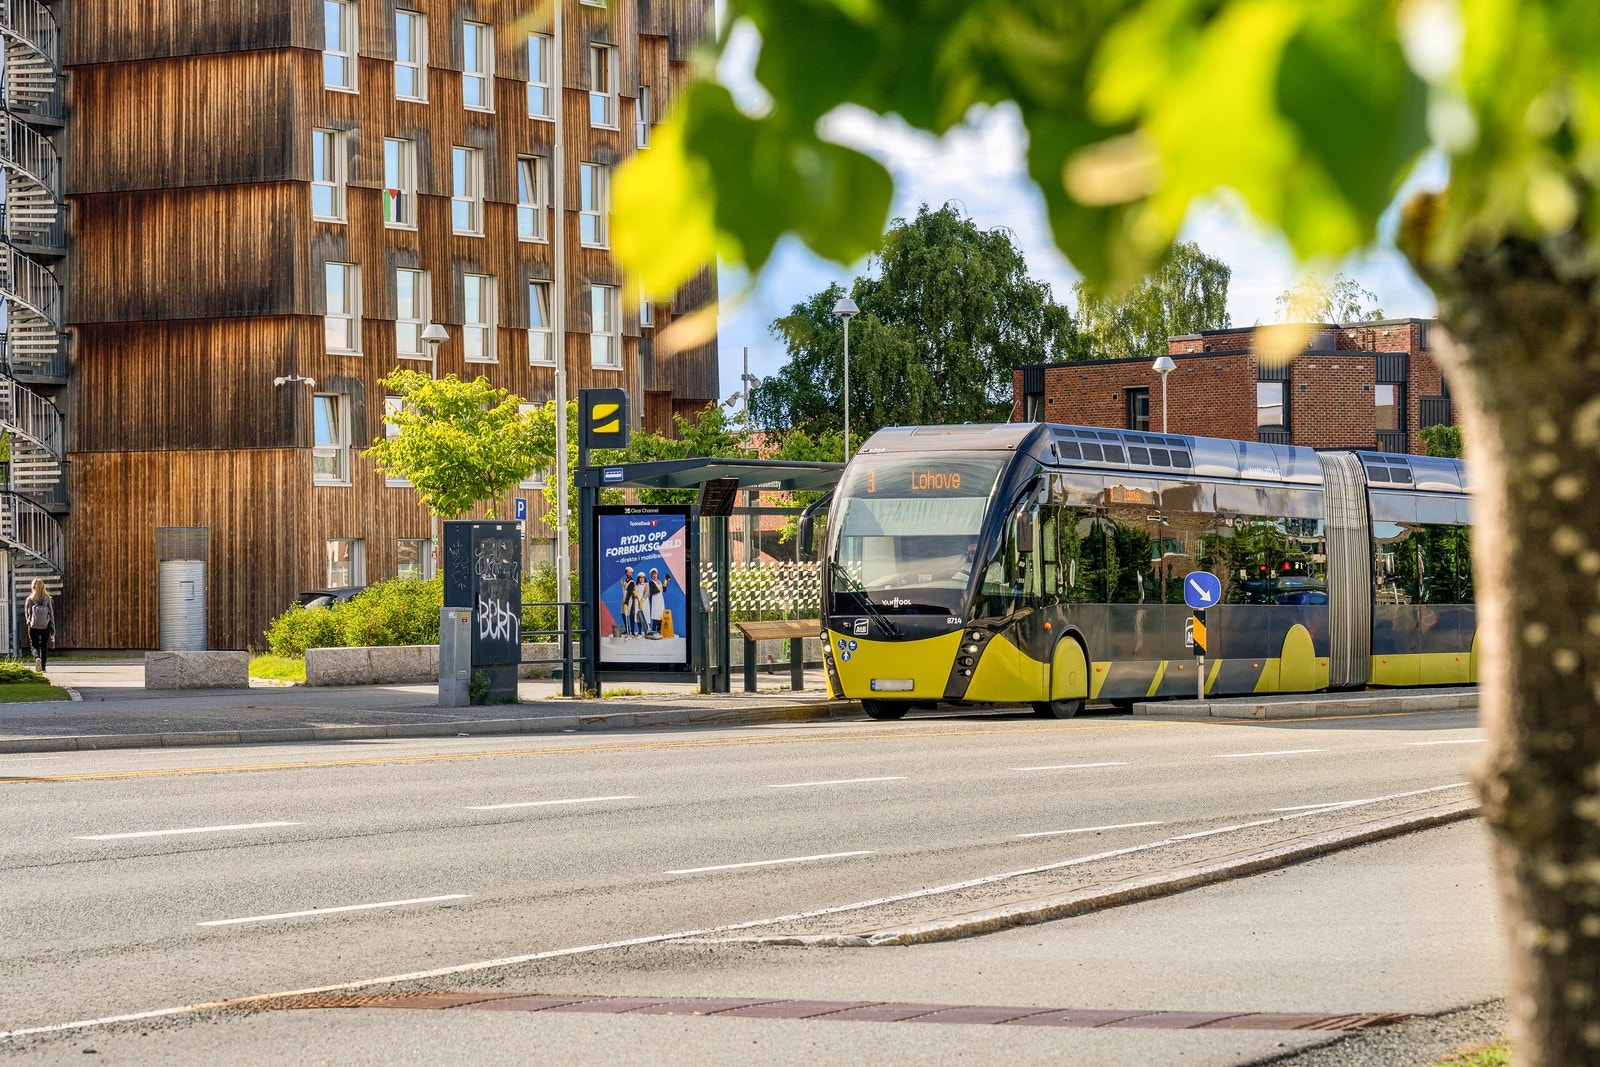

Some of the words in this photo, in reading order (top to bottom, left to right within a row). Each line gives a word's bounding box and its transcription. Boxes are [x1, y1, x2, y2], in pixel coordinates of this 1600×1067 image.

[911, 470, 961, 490] Lohove
[517, 501, 525, 517] P
[620, 535, 646, 545] RYDD
[648, 531, 667, 542] OPP
[605, 540, 682, 557] FORBRUKSGJELD
